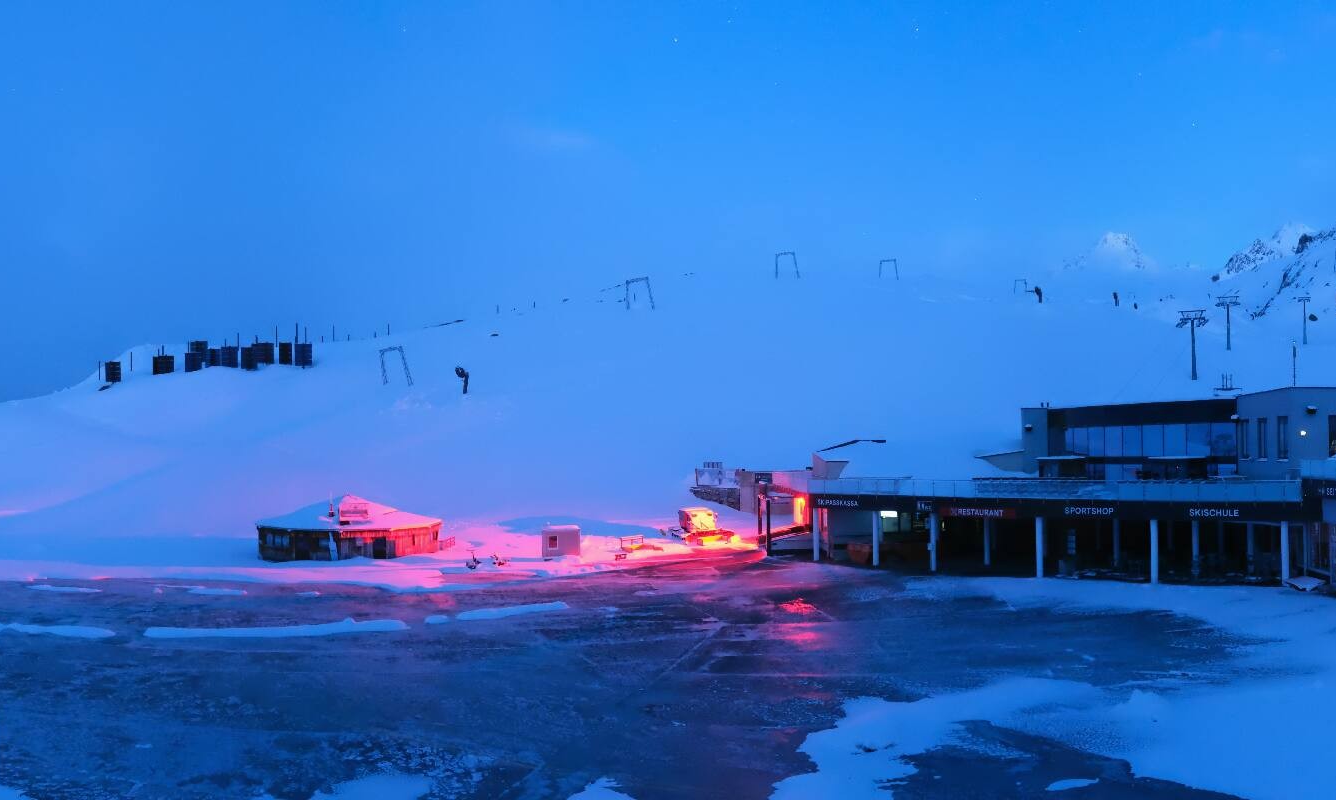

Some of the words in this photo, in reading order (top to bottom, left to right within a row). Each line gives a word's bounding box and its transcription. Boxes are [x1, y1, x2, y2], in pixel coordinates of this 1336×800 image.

[958, 508, 1004, 517] RESTAURANT
[1064, 507, 1114, 515] SPORTSHOP
[1189, 508, 1240, 517] SKISCHULE
